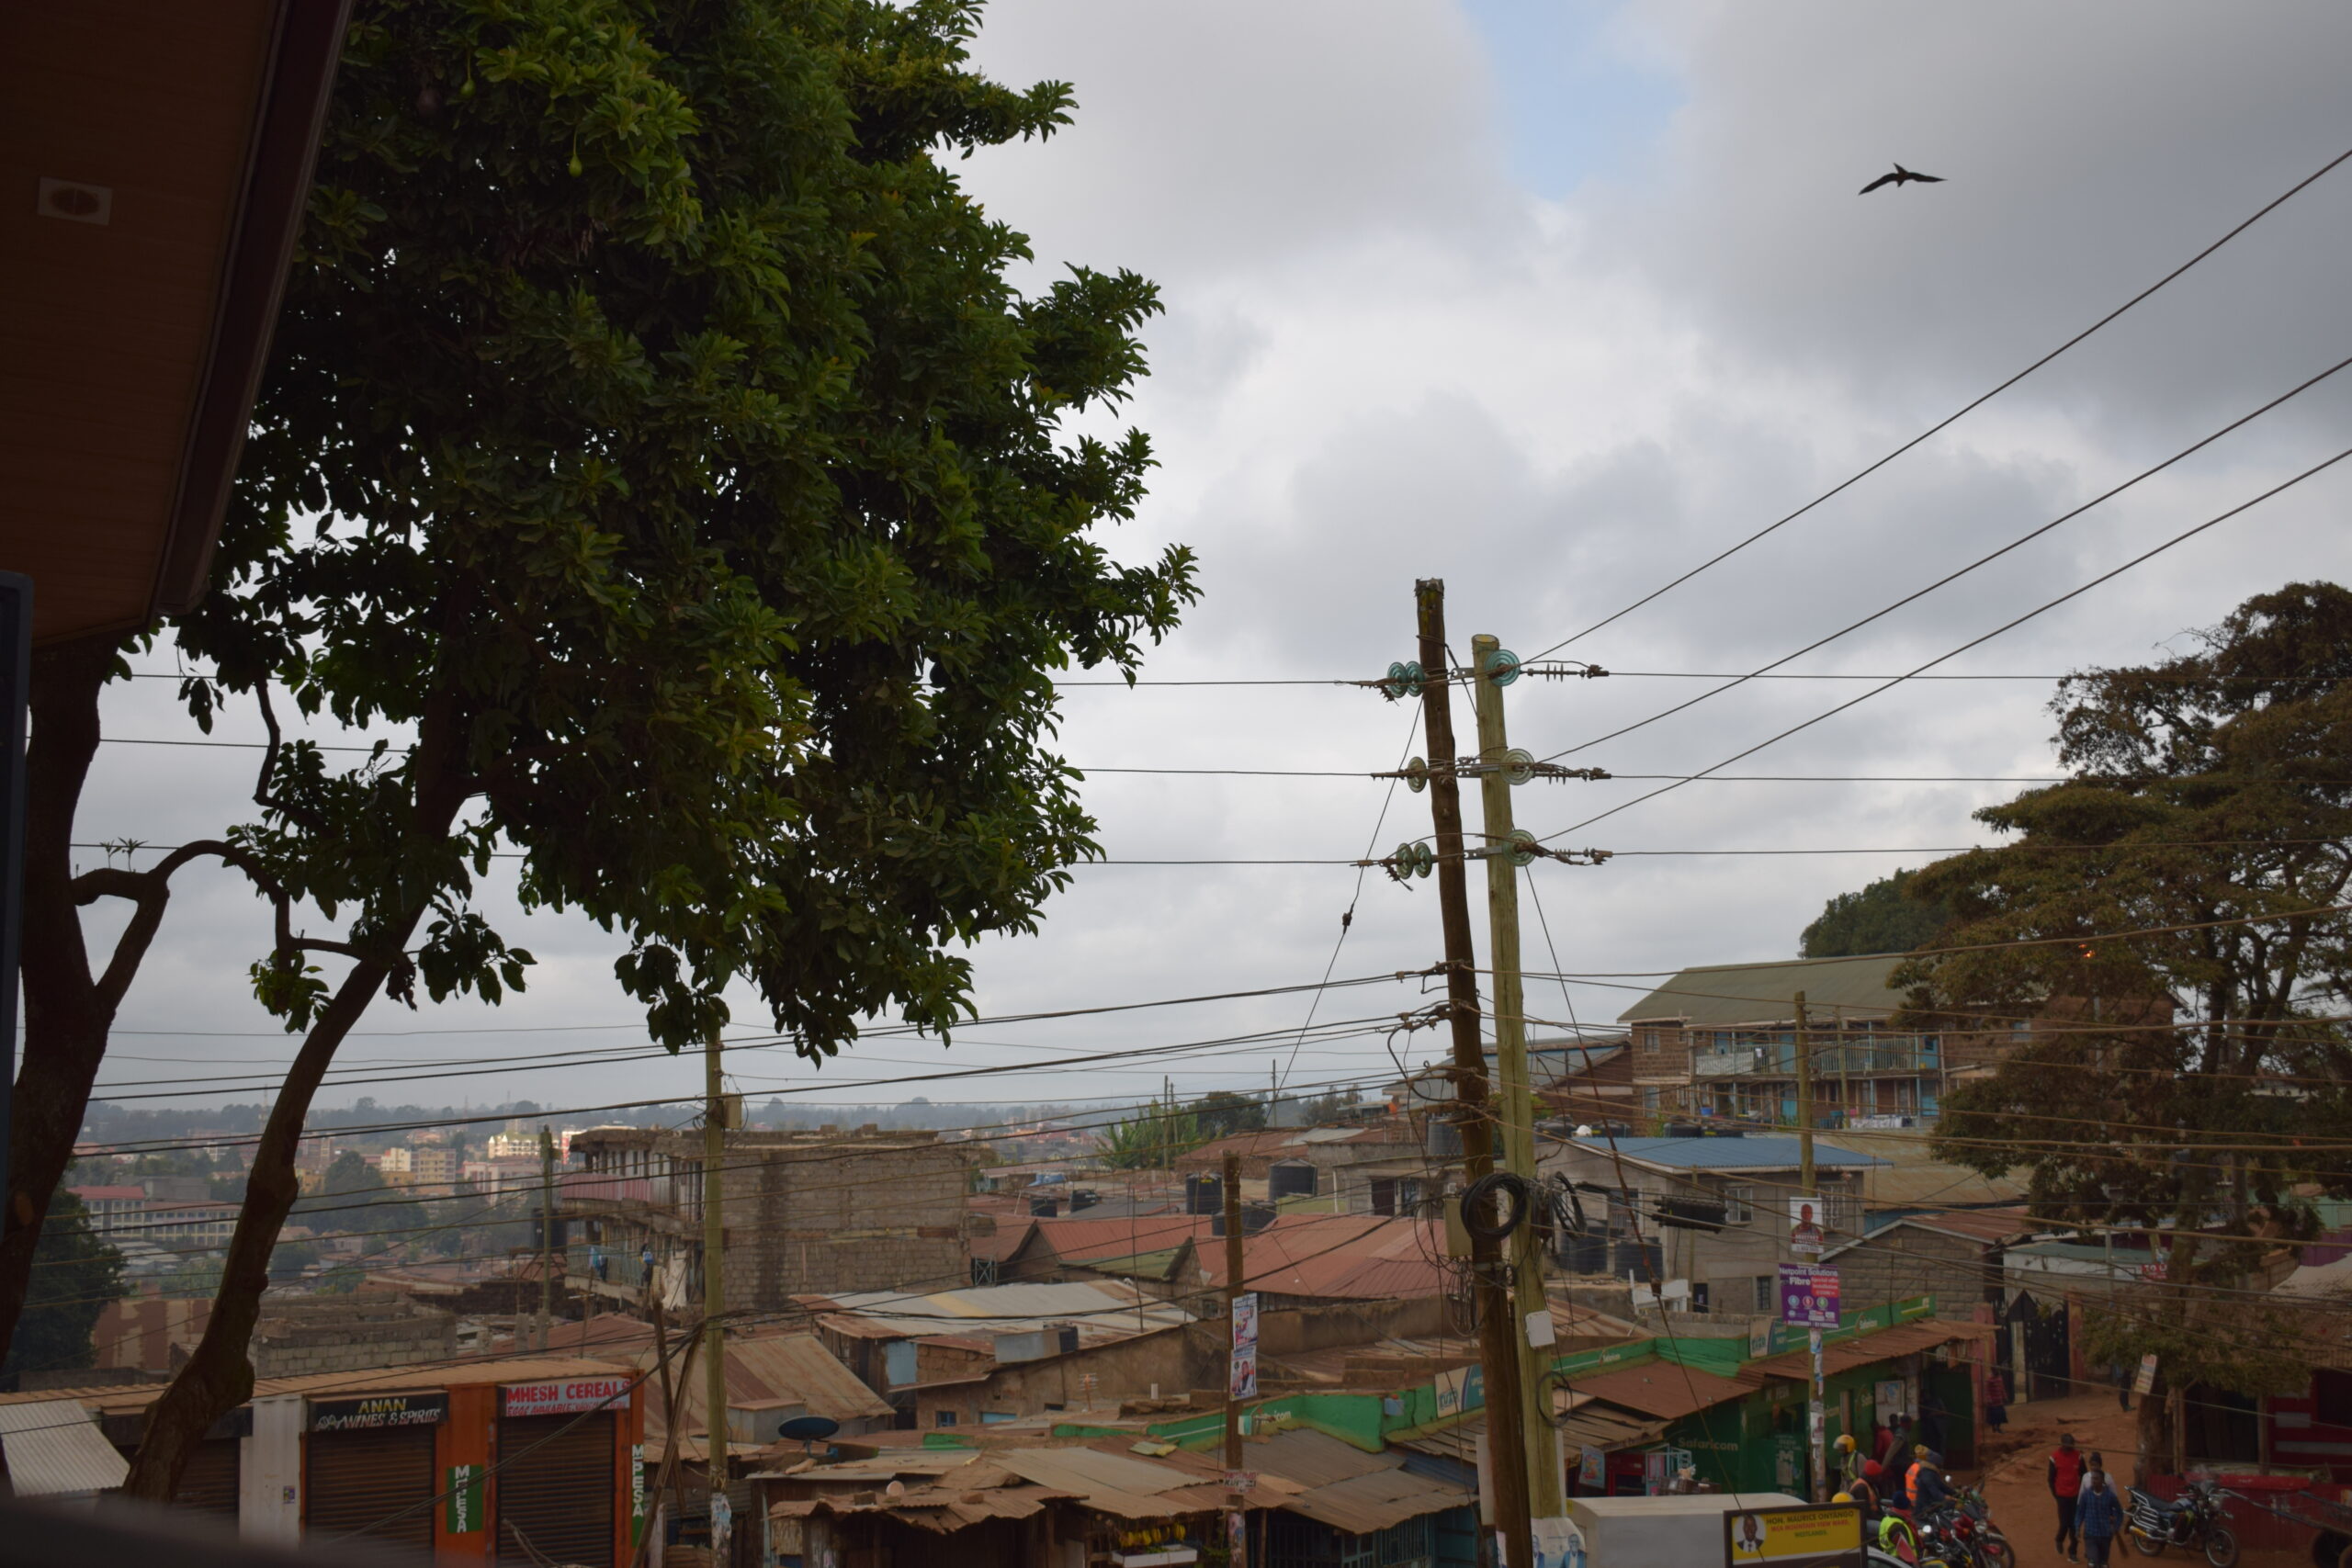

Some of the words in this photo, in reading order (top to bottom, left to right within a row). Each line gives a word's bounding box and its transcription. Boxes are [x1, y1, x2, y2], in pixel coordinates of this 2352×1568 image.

[1779, 1268, 1806, 1277] Netpoint
[1808, 1269, 1838, 1277] Solutions
[1789, 1277, 1811, 1286] Fibre
[507, 1385, 559, 1404] MHESH
[358, 1398, 407, 1414] ANAN
[343, 1413, 386, 1429] WINES
[388, 1412, 398, 1427] &
[398, 1408, 441, 1426] SPIRITS
[1767, 1517, 1785, 1525] HON.
[1788, 1514, 1816, 1523] MAURICE
[1818, 1511, 1854, 1520] ONYANGO
